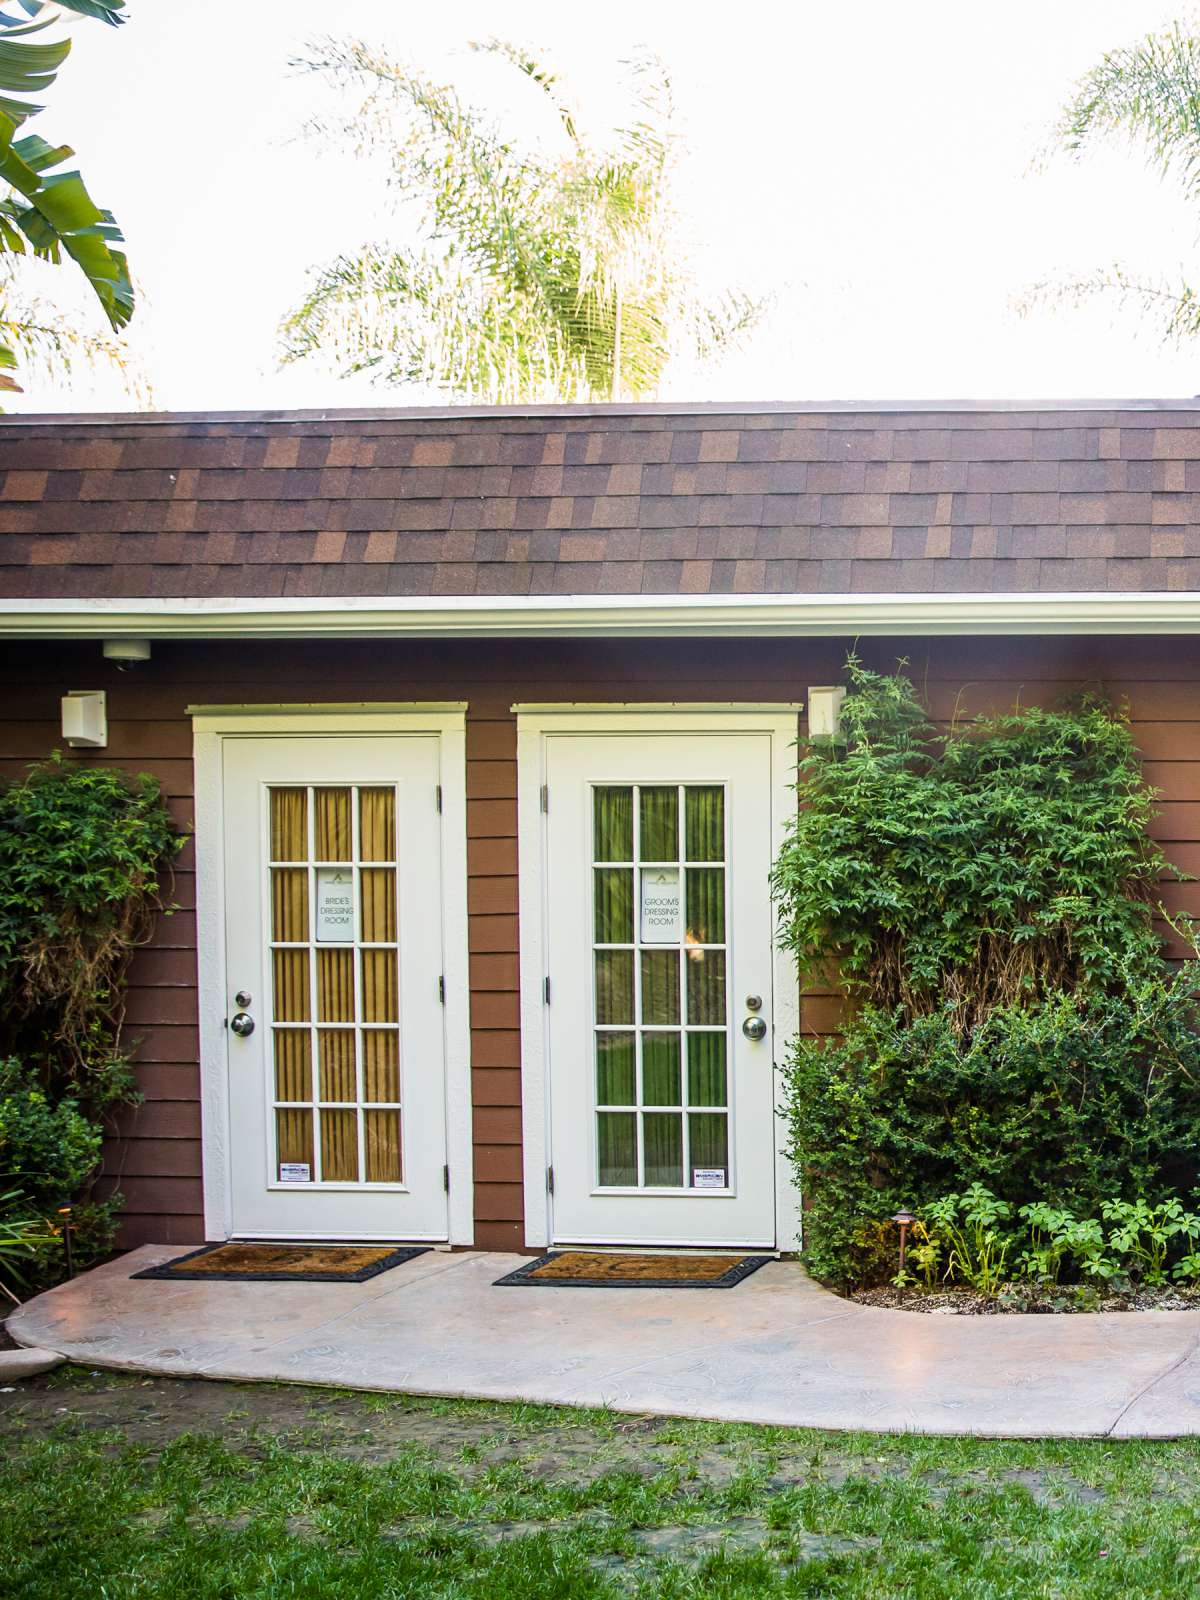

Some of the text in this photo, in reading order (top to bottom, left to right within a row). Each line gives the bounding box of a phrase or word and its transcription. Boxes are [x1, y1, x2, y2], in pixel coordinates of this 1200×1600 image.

[644, 898, 679, 906] GROOM'S
[320, 907, 354, 915] DRESSING
[644, 908, 679, 916] DRESSING
[324, 916, 349, 924] ROOM
[648, 917, 674, 926] ROOM
